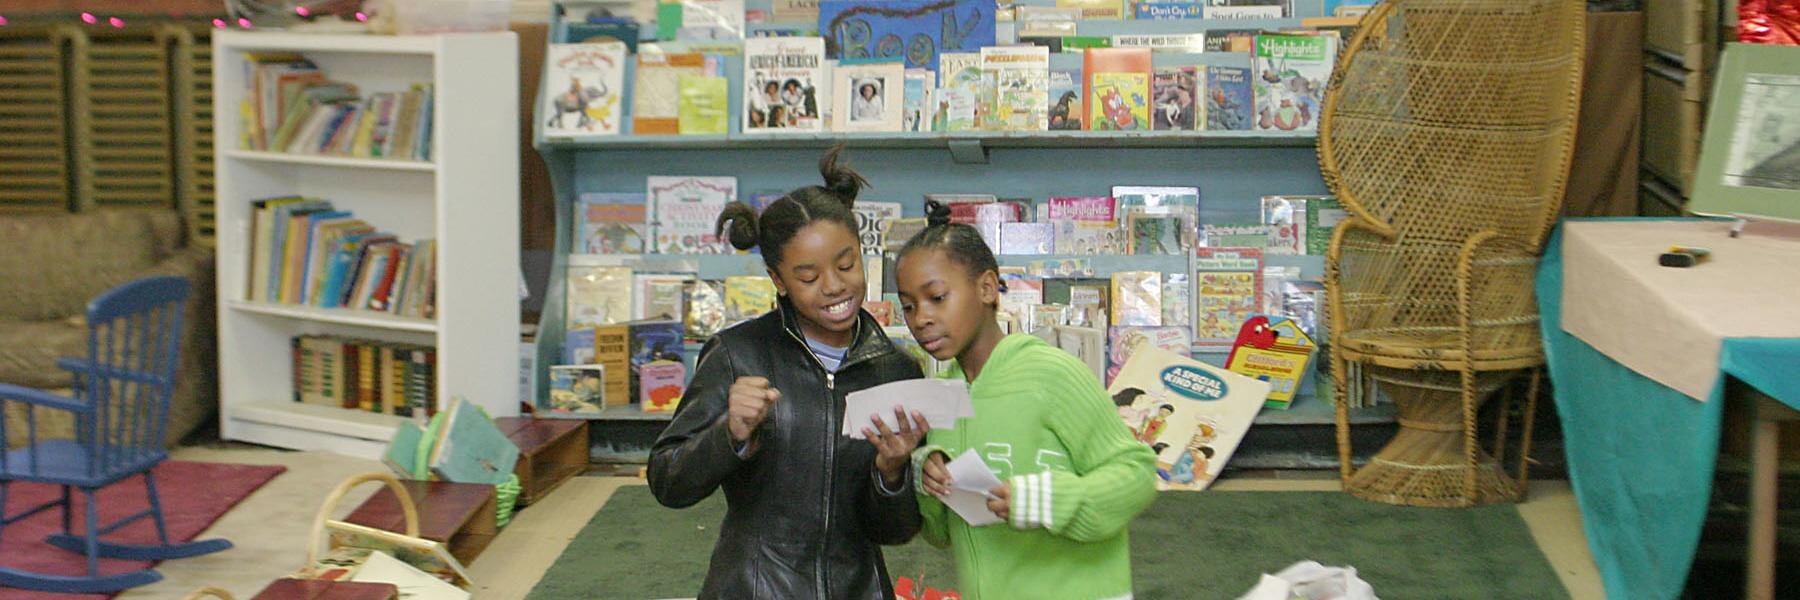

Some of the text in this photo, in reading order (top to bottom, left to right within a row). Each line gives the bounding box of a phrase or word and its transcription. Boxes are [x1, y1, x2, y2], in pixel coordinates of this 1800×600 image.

[1261, 38, 1321, 56] Highlights
[1055, 199, 1110, 217] Highlights
[1164, 373, 1222, 399] KIND OF ME
[1173, 367, 1222, 389] A SPECIAL
